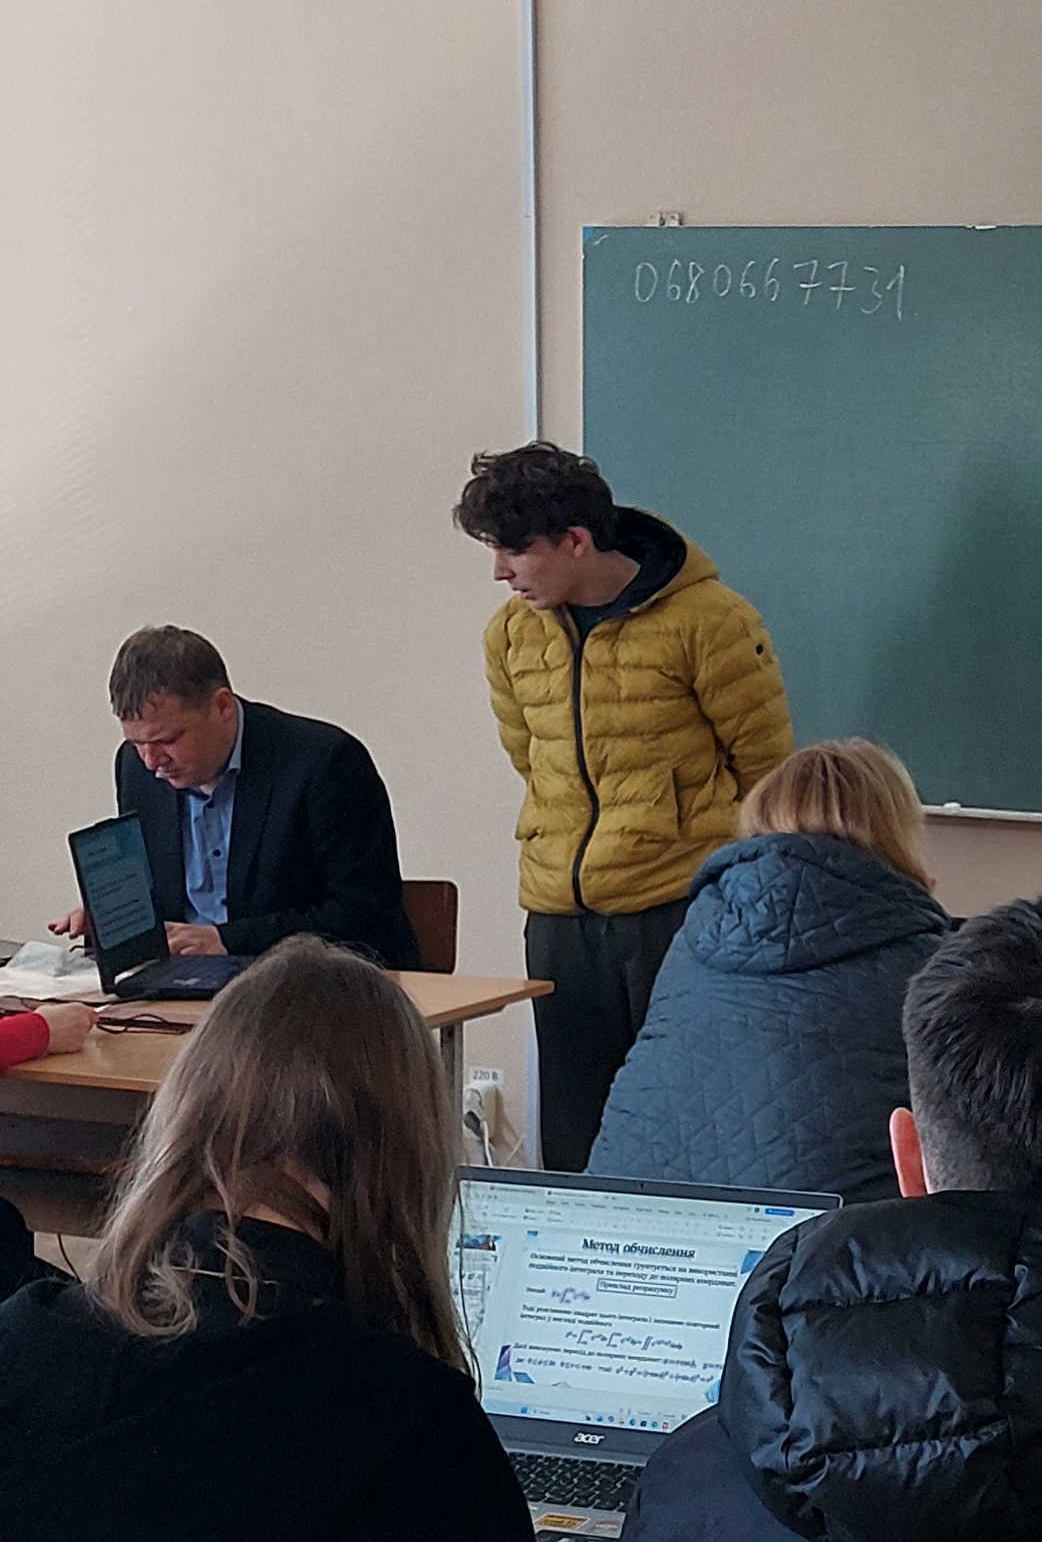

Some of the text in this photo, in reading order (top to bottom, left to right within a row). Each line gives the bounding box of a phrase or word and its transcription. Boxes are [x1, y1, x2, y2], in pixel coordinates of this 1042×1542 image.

[582, 1238, 696, 1260] Метод обчислення
[574, 1432, 605, 1445] acer
